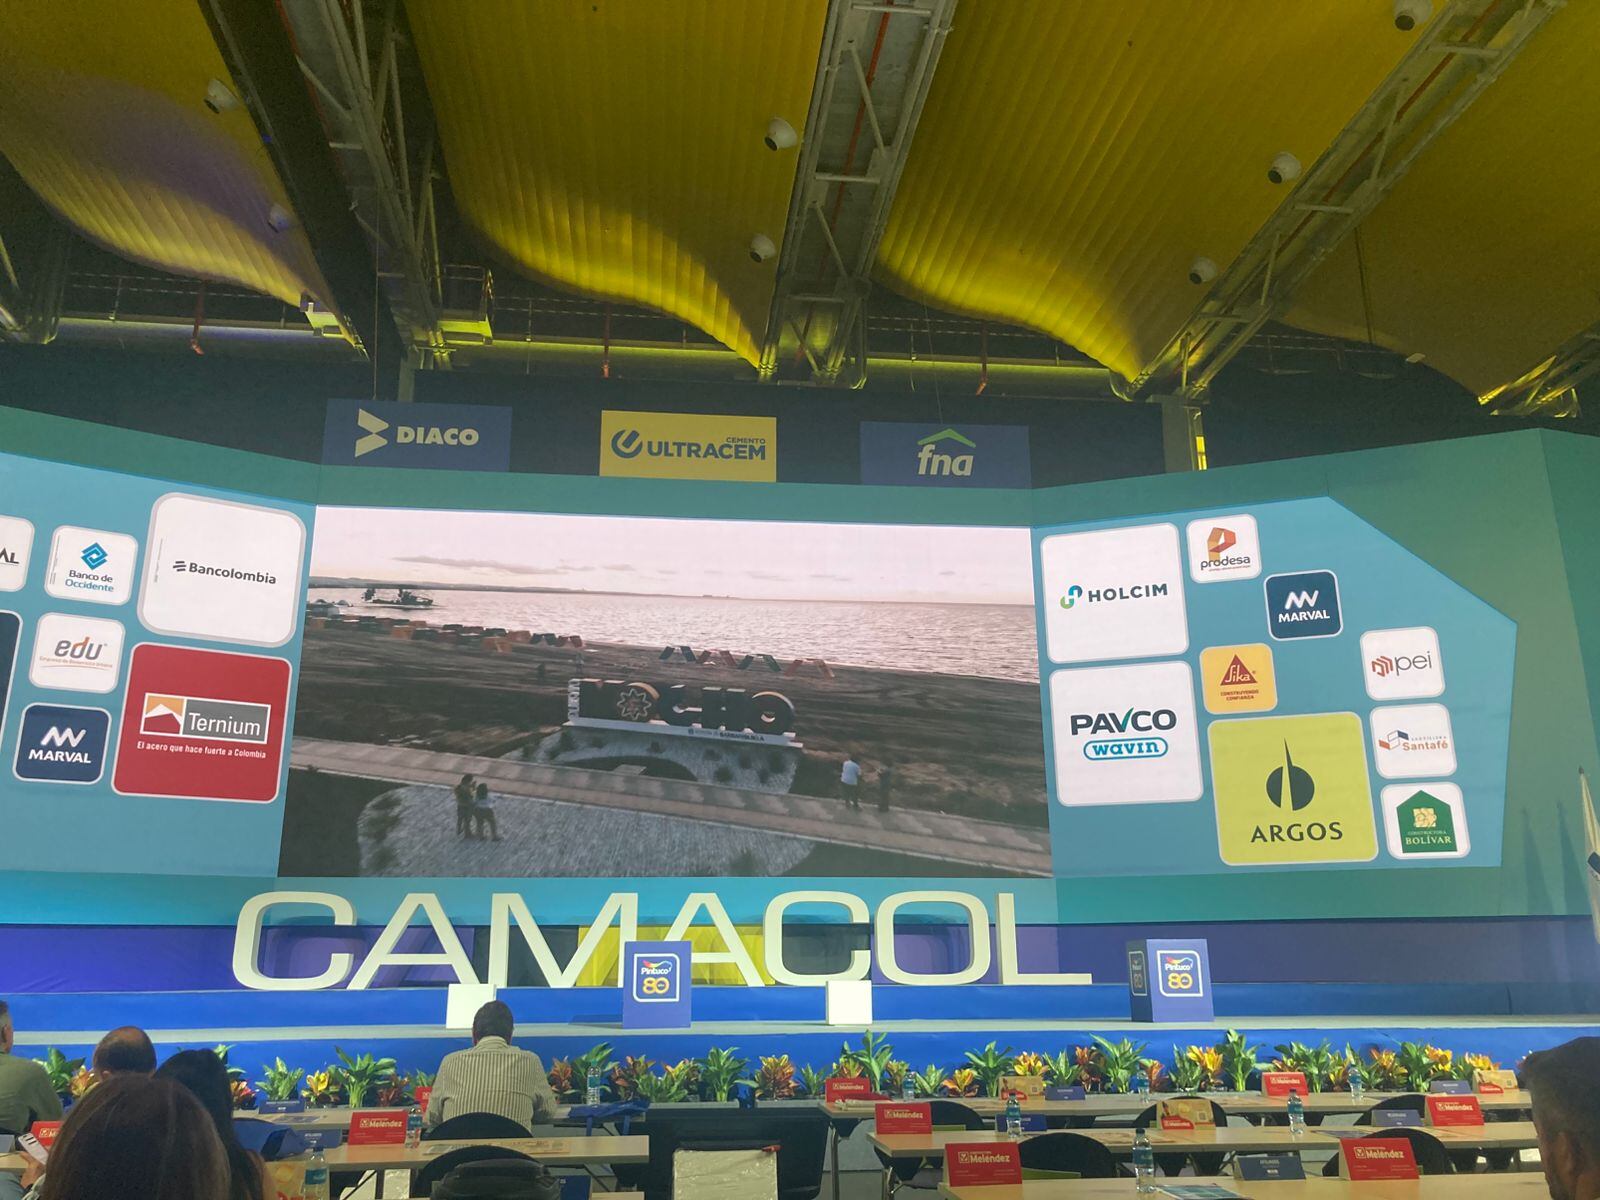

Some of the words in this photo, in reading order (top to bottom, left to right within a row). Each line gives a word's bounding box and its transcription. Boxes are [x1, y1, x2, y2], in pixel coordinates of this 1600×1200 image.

[396, 426, 479, 446] DIACO
[726, 436, 766, 445] CEMENTO
[647, 440, 766, 460] ULTRACEM
[917, 443, 974, 476] fna
[1200, 556, 1251, 571] prodesa
[68, 569, 99, 581] Banco
[101, 574, 113, 583] de
[188, 562, 277, 585] Bancolombia
[65, 579, 114, 592] Occidente
[1088, 583, 1168, 602] HOLCIM
[1278, 610, 1330, 623] MARVAL
[54, 636, 103, 660] edu
[1394, 650, 1432, 676] pei
[1225, 664, 1251, 683] Sika
[188, 712, 261, 737] Ternium
[1070, 707, 1177, 735] PAVCO
[137, 741, 145, 749] El
[146, 742, 168, 751] acero
[169, 744, 183, 753] que
[185, 745, 203, 754] hace
[204, 746, 226, 756] fuerte
[234, 748, 267, 759] Colombia
[1092, 741, 1160, 757] wavin
[1402, 740, 1449, 751] Santafé
[28, 749, 91, 764] MARVAL
[1251, 822, 1343, 843] ARGOS
[1405, 835, 1452, 845] BOLÍVAR
[232, 891, 1093, 990] CAMACOL
[640, 967, 670, 975] Pintuco
[1164, 963, 1192, 971] Pintuco
[642, 977, 670, 995] 80
[1168, 972, 1193, 989] 80
